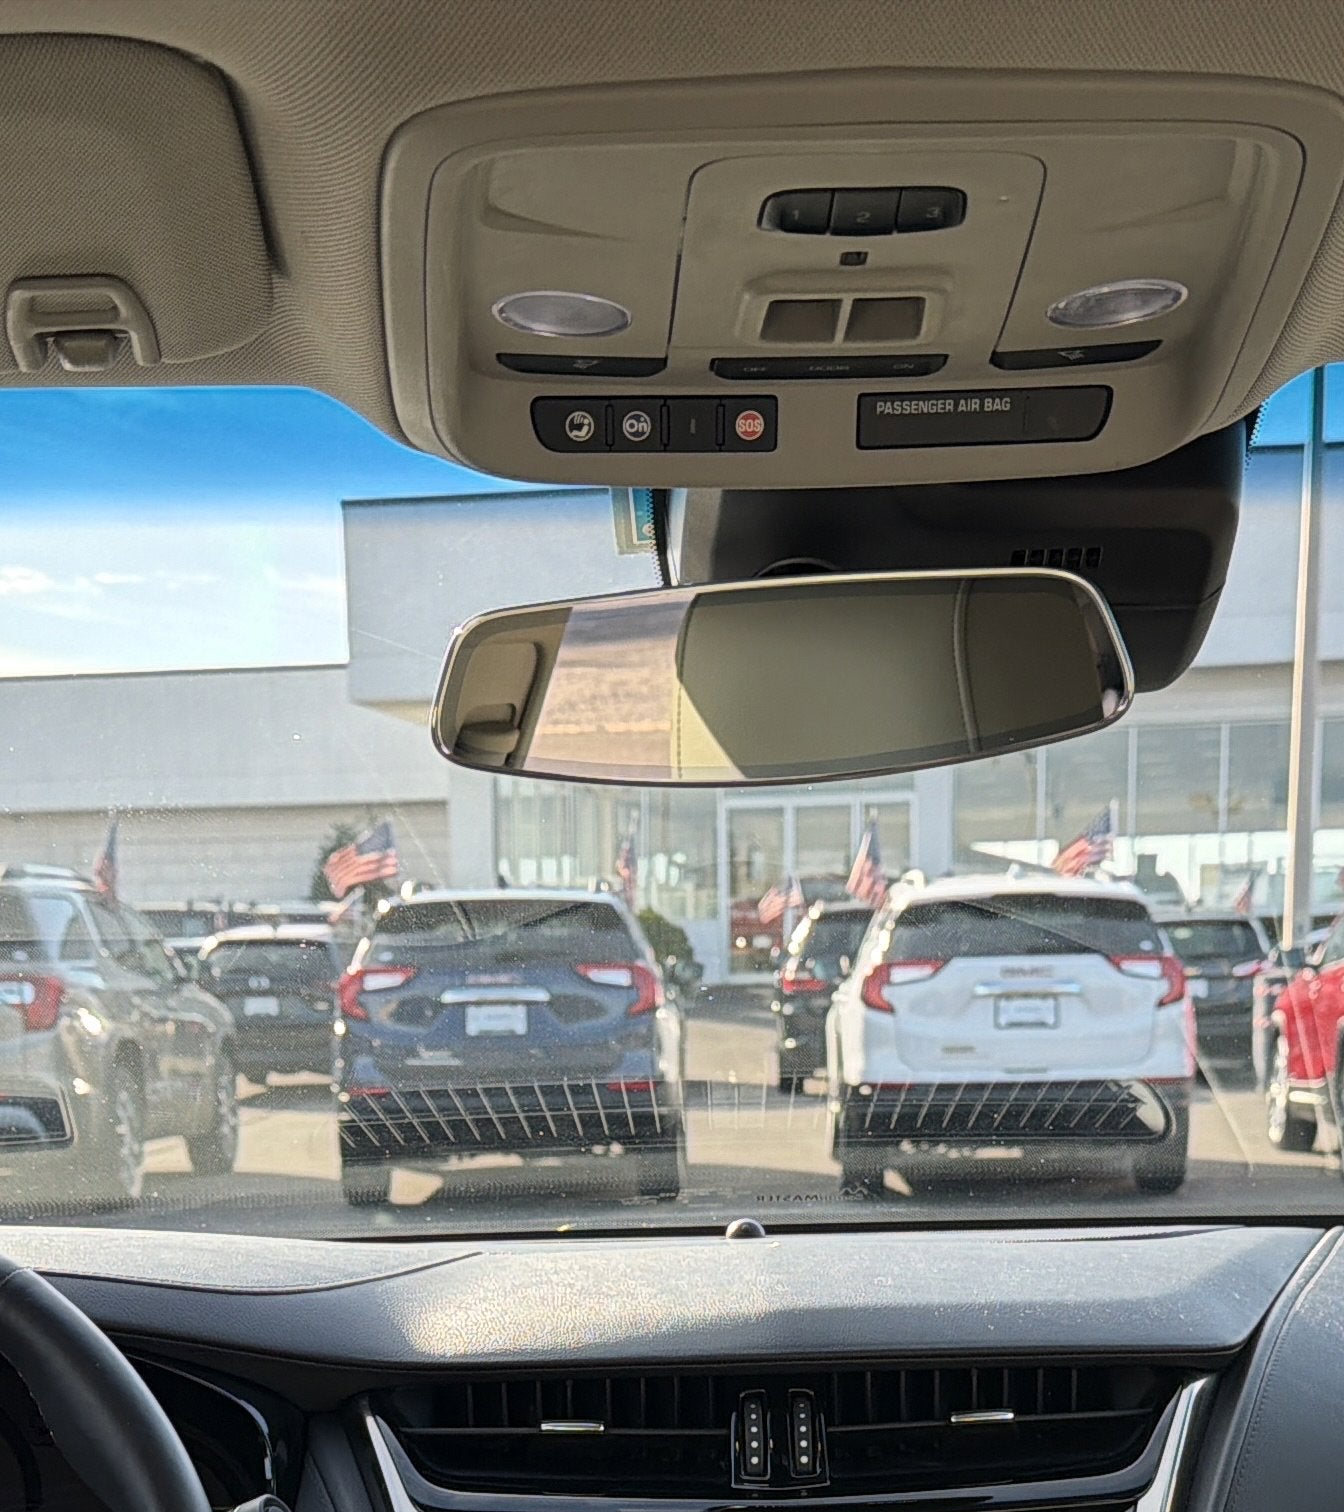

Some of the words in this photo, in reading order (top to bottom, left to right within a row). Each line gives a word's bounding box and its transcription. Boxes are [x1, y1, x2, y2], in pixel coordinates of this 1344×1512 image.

[856, 211, 871, 222] 2
[926, 207, 940, 218] 3
[876, 399, 954, 416] PASSENGER
[958, 398, 981, 413] AIR
[984, 397, 1011, 412] BAG
[738, 417, 762, 434] SOS
